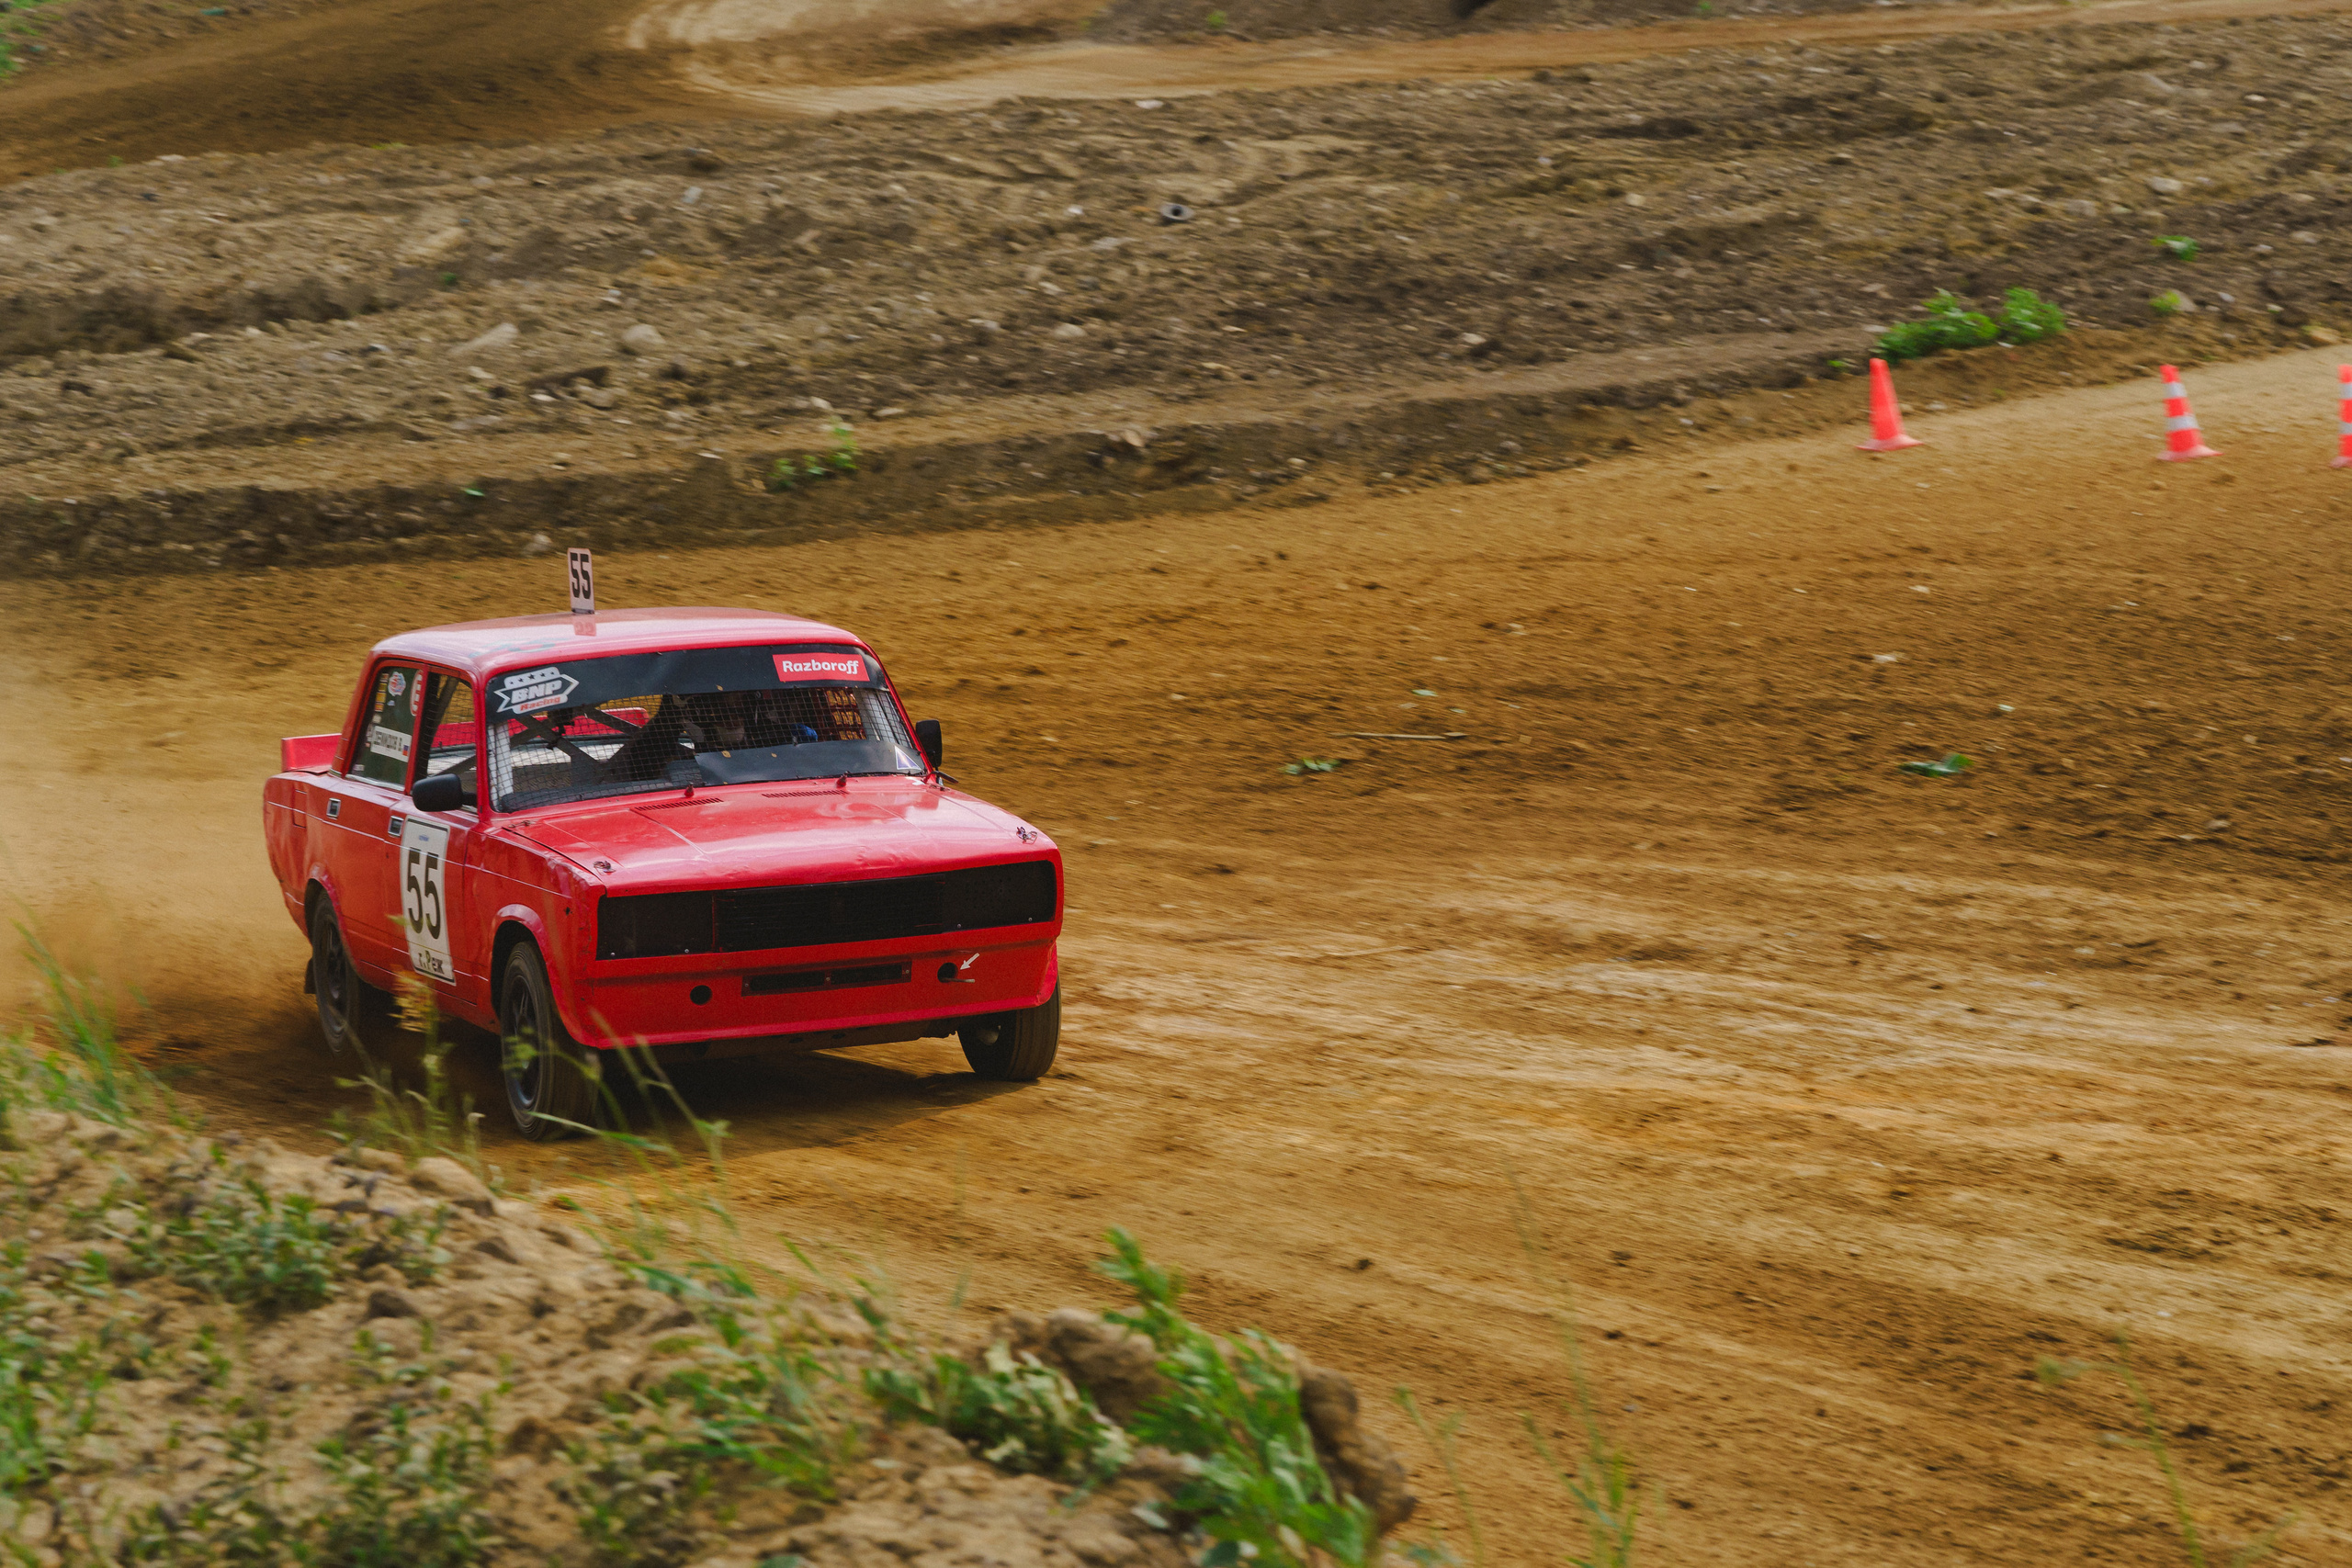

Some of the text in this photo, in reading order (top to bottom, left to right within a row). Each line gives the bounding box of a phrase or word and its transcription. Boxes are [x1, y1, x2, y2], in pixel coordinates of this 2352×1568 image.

[570, 551, 591, 600] 55
[782, 659, 859, 675] Razboroff
[511, 680, 562, 704] BNP
[520, 696, 560, 712] Racing
[407, 846, 441, 940] 55
